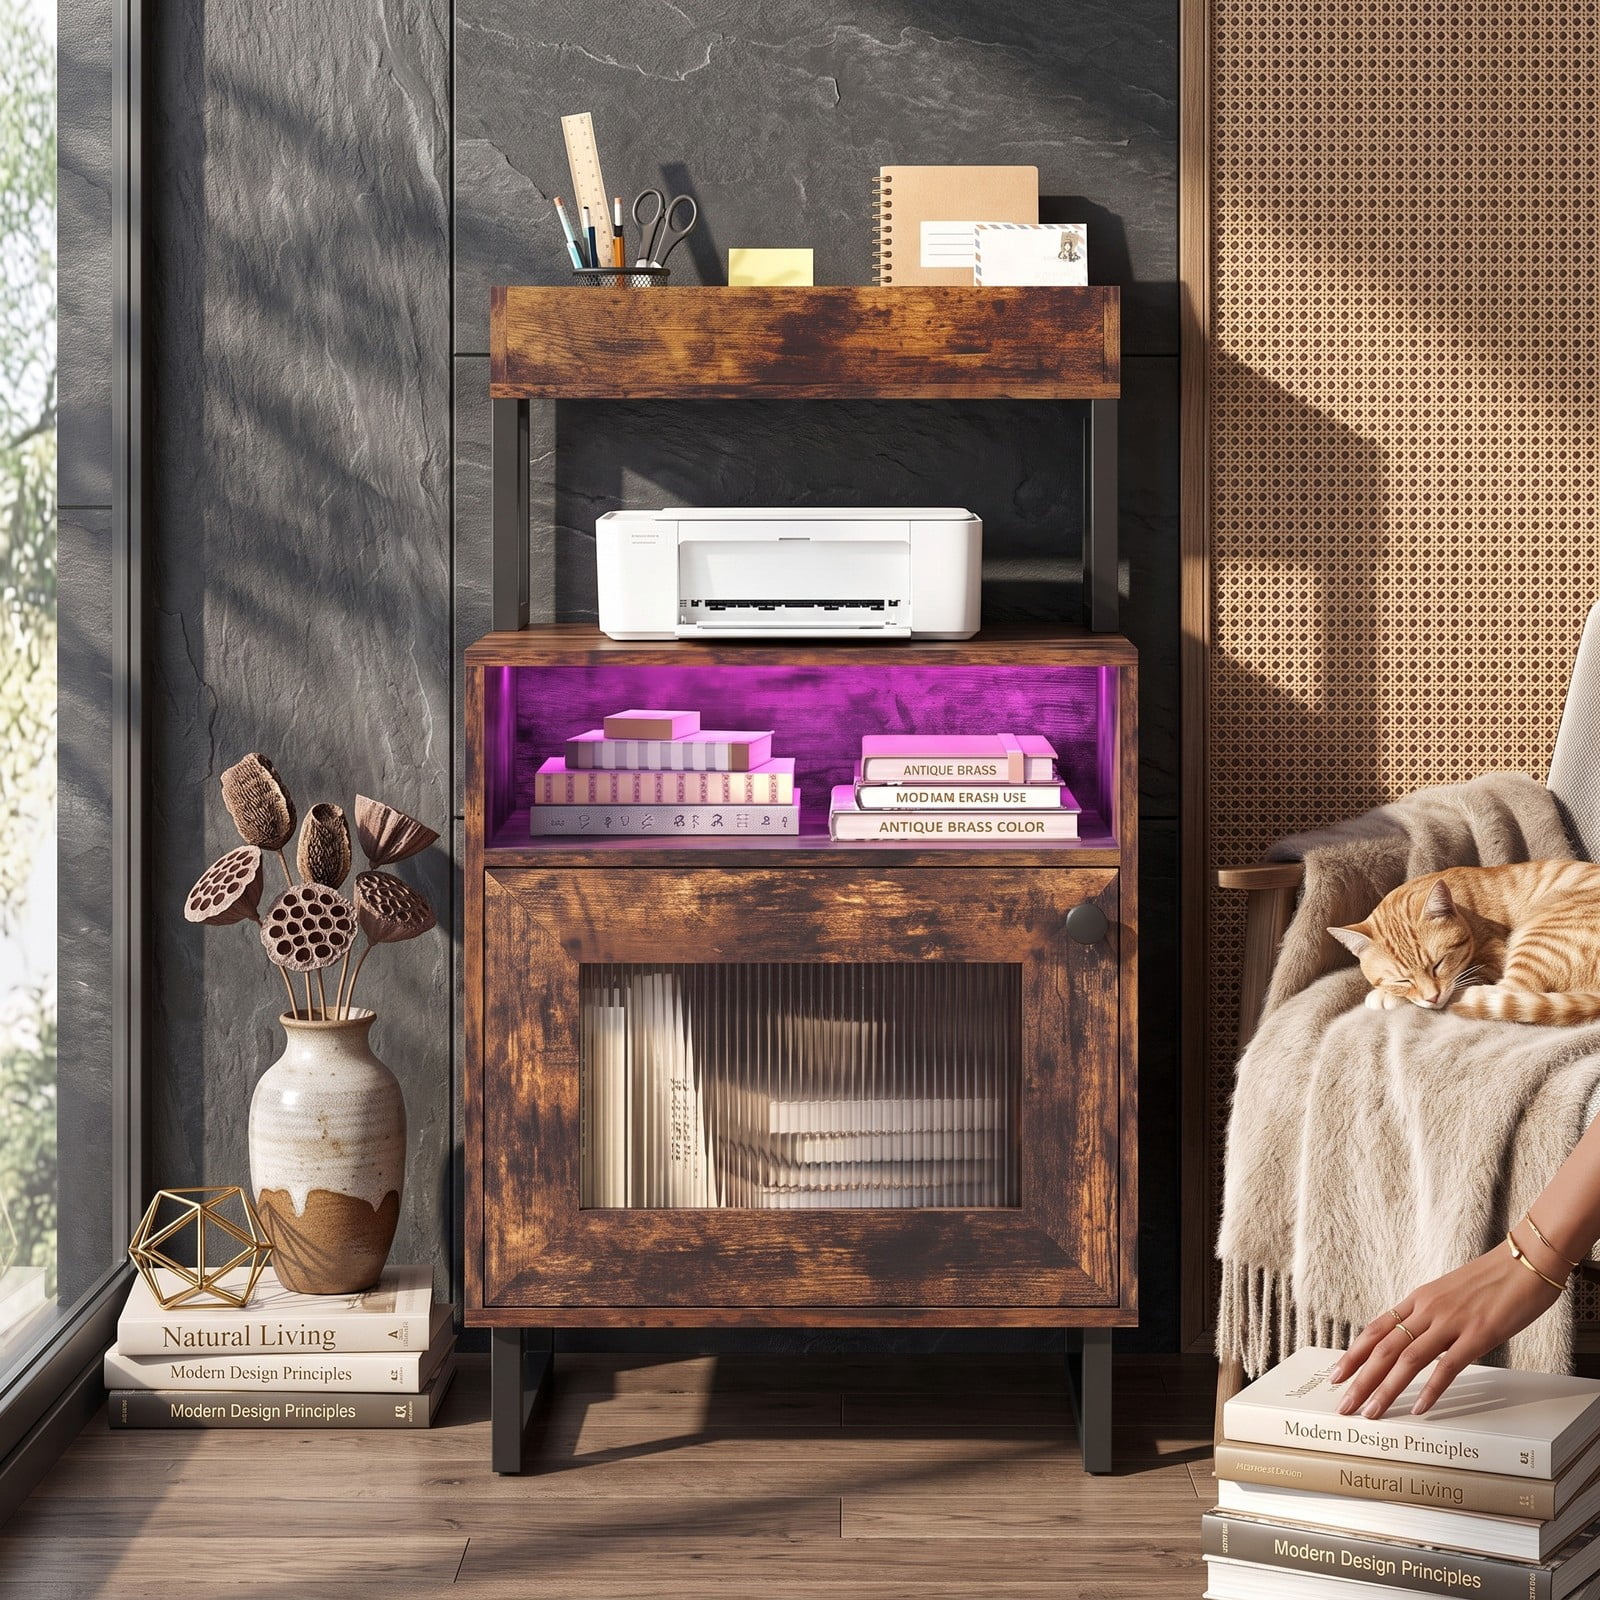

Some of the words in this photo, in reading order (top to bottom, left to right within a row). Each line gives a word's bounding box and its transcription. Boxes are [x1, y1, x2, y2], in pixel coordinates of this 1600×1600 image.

[903, 765, 953, 777] ANTIQUE
[957, 765, 997, 776] BRASS
[1003, 792, 1026, 803] USE
[879, 821, 943, 834] ANTIQUE
[948, 821, 993, 833] BRASS
[997, 821, 1045, 833] COLOR
[162, 1325, 250, 1348] Natural
[260, 1323, 336, 1350] Living
[171, 1365, 225, 1379] Modern
[230, 1366, 278, 1383] Design
[283, 1366, 352, 1384] Principles
[171, 1403, 226, 1418] Modern
[231, 1403, 280, 1421] Design
[285, 1403, 356, 1421] Principles
[1284, 1420, 1342, 1442] Modern
[1347, 1428, 1399, 1451] Design
[1404, 1435, 1480, 1459] Principles
[1340, 1469, 1403, 1493] Natural
[1410, 1478, 1464, 1505] Living
[1274, 1539, 1335, 1564] Modern
[1341, 1550, 1396, 1577] Design
[1402, 1560, 1482, 1589] Principles
